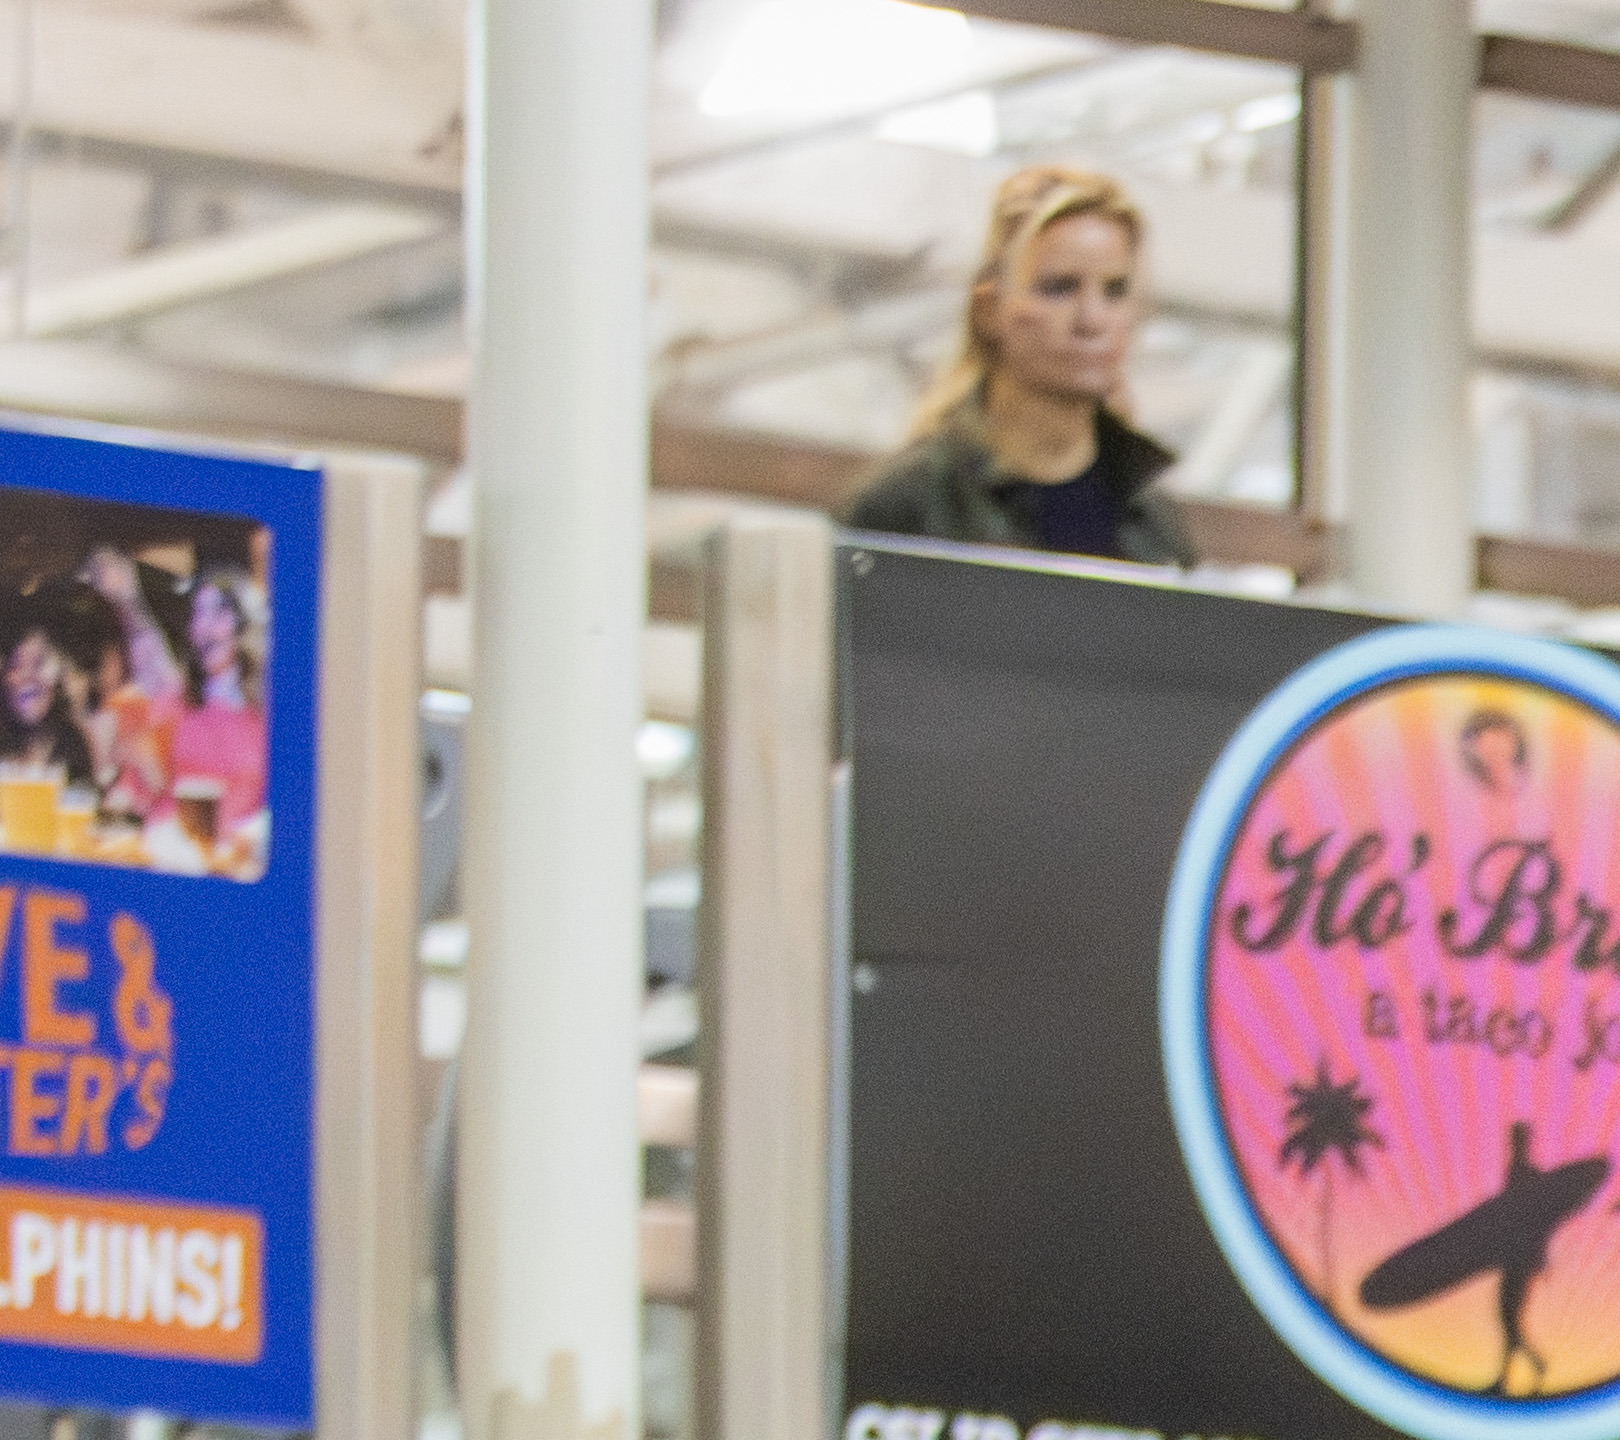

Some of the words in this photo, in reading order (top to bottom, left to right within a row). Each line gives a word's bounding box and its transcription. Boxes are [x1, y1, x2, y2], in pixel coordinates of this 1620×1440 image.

[1363, 988, 1397, 1041] a
[1422, 985, 1553, 1060] taco
[0, 1210, 243, 1331] PHINS!
